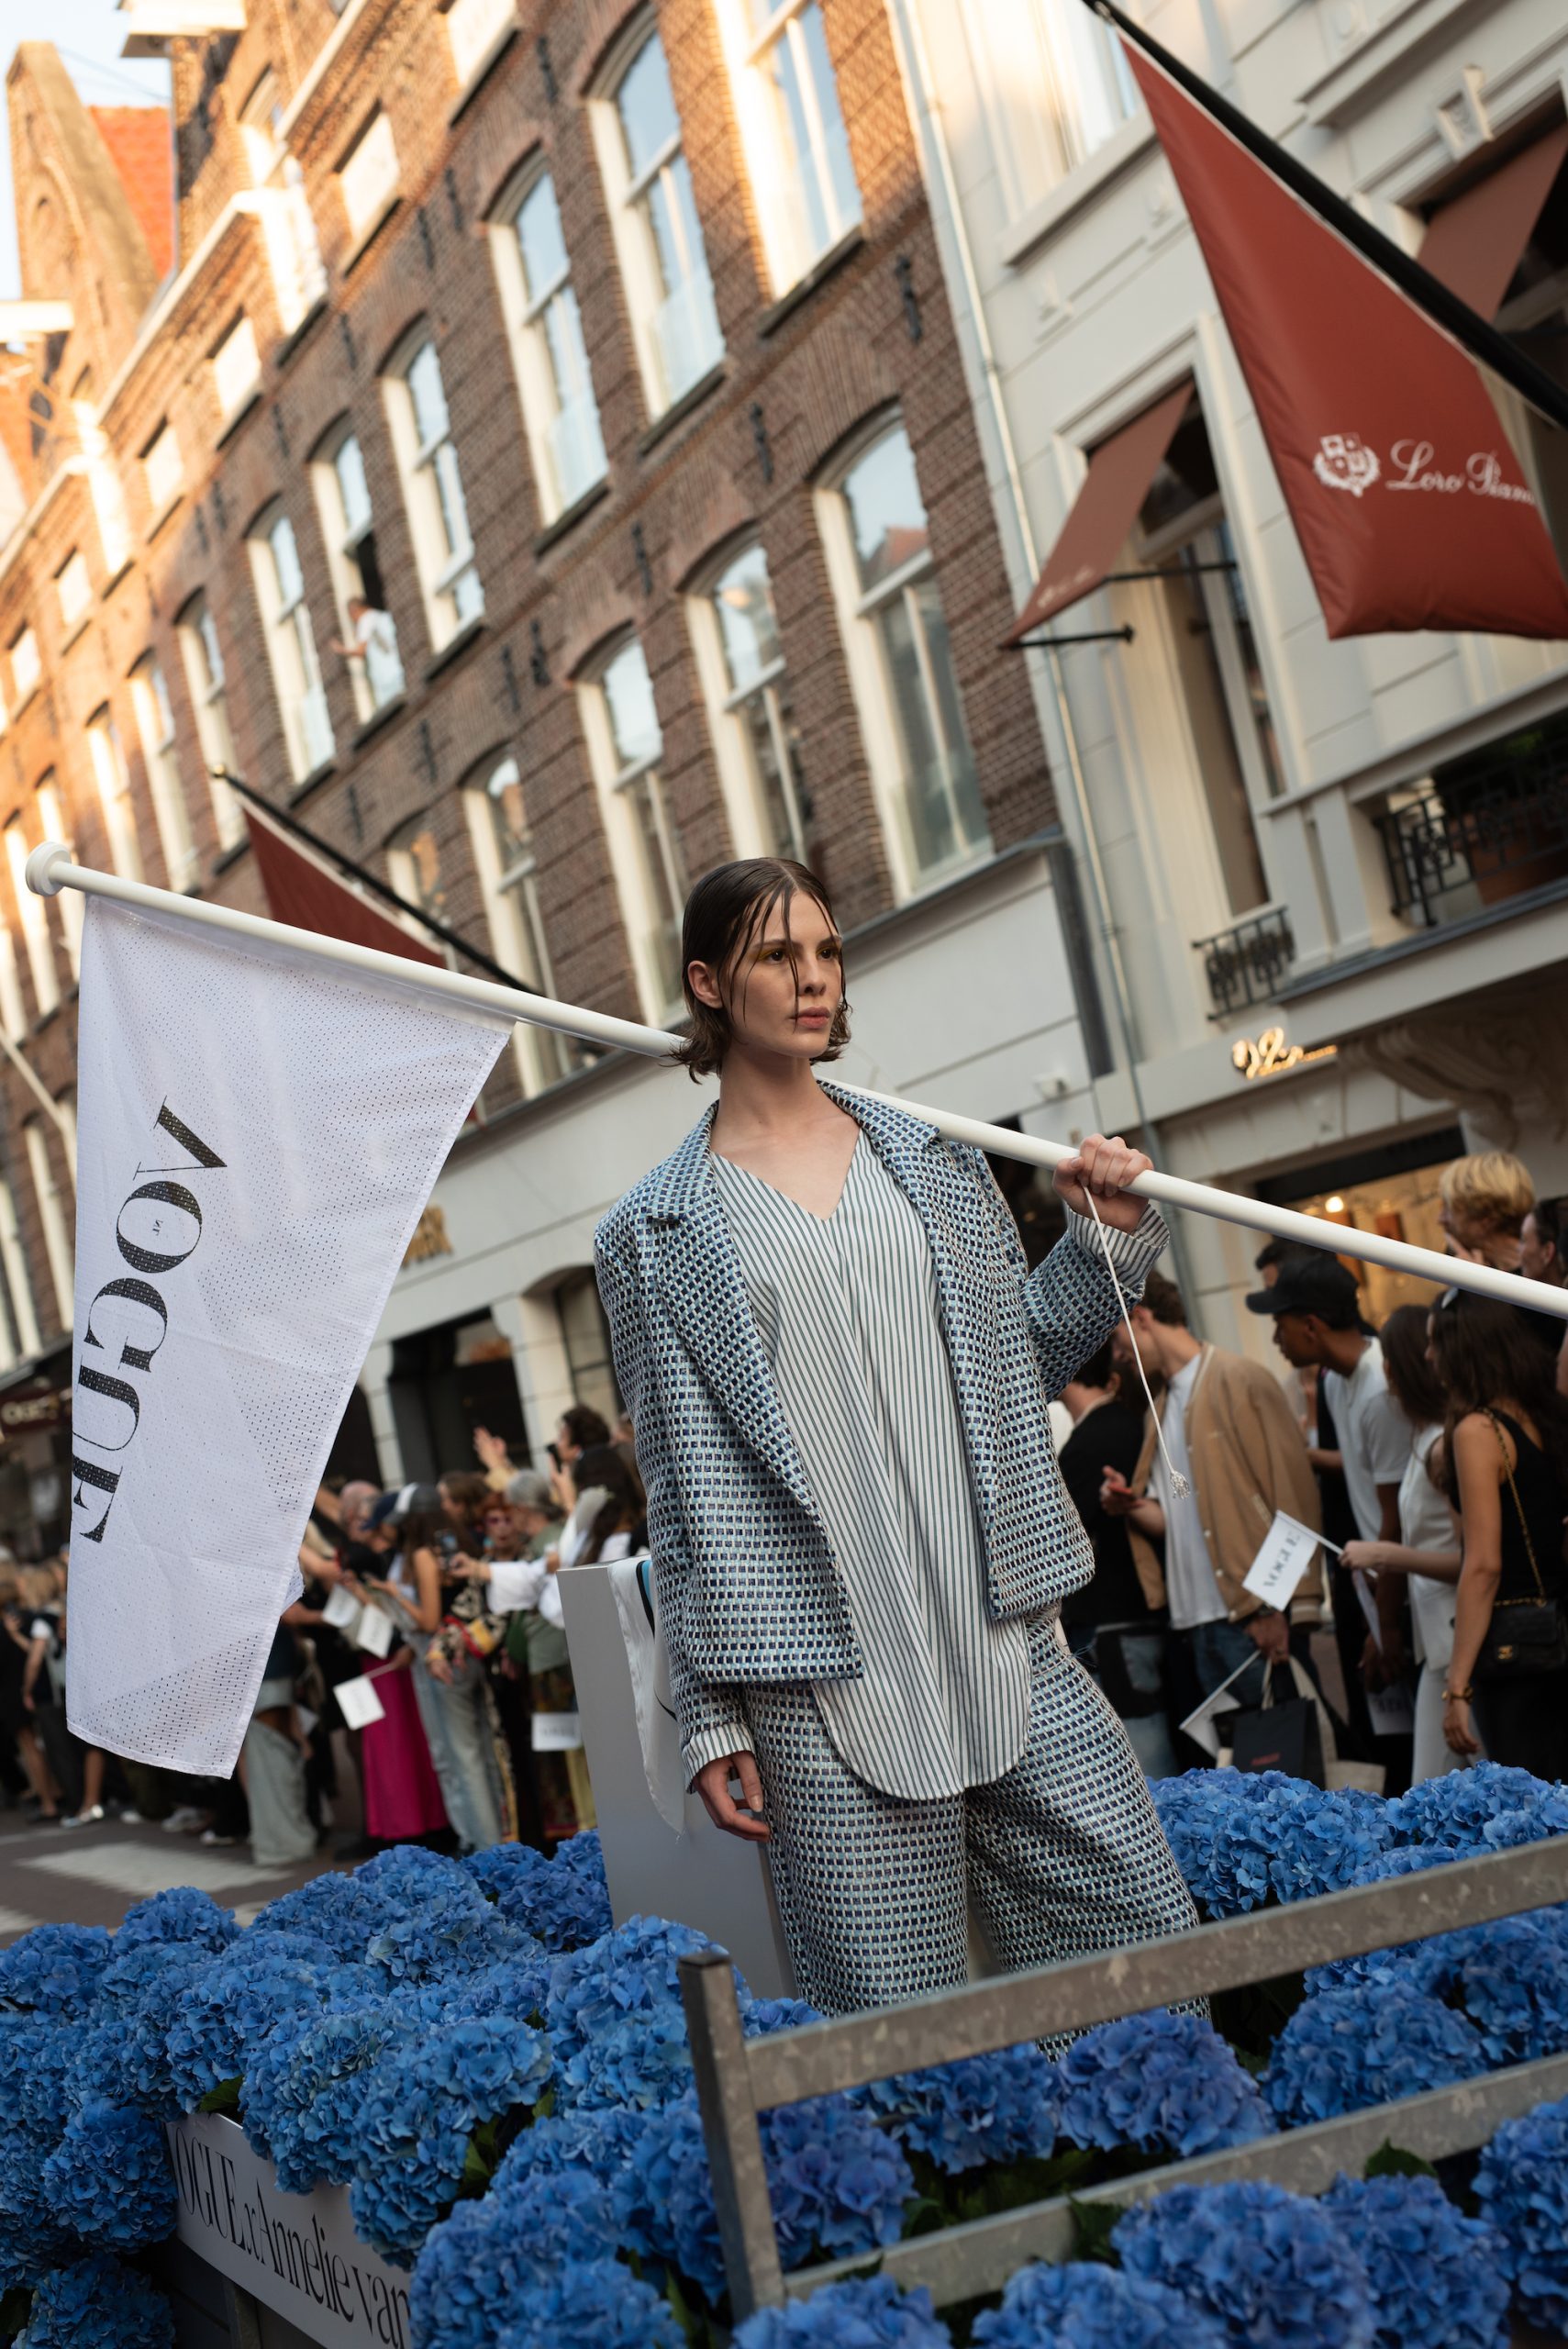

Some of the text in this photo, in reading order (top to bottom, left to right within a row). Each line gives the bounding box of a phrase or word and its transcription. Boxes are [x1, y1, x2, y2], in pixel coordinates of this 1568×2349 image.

[1385, 439, 1466, 493] Loro
[175, 2127, 246, 2251] OGUE
[256, 2178, 354, 2322] Annelie
